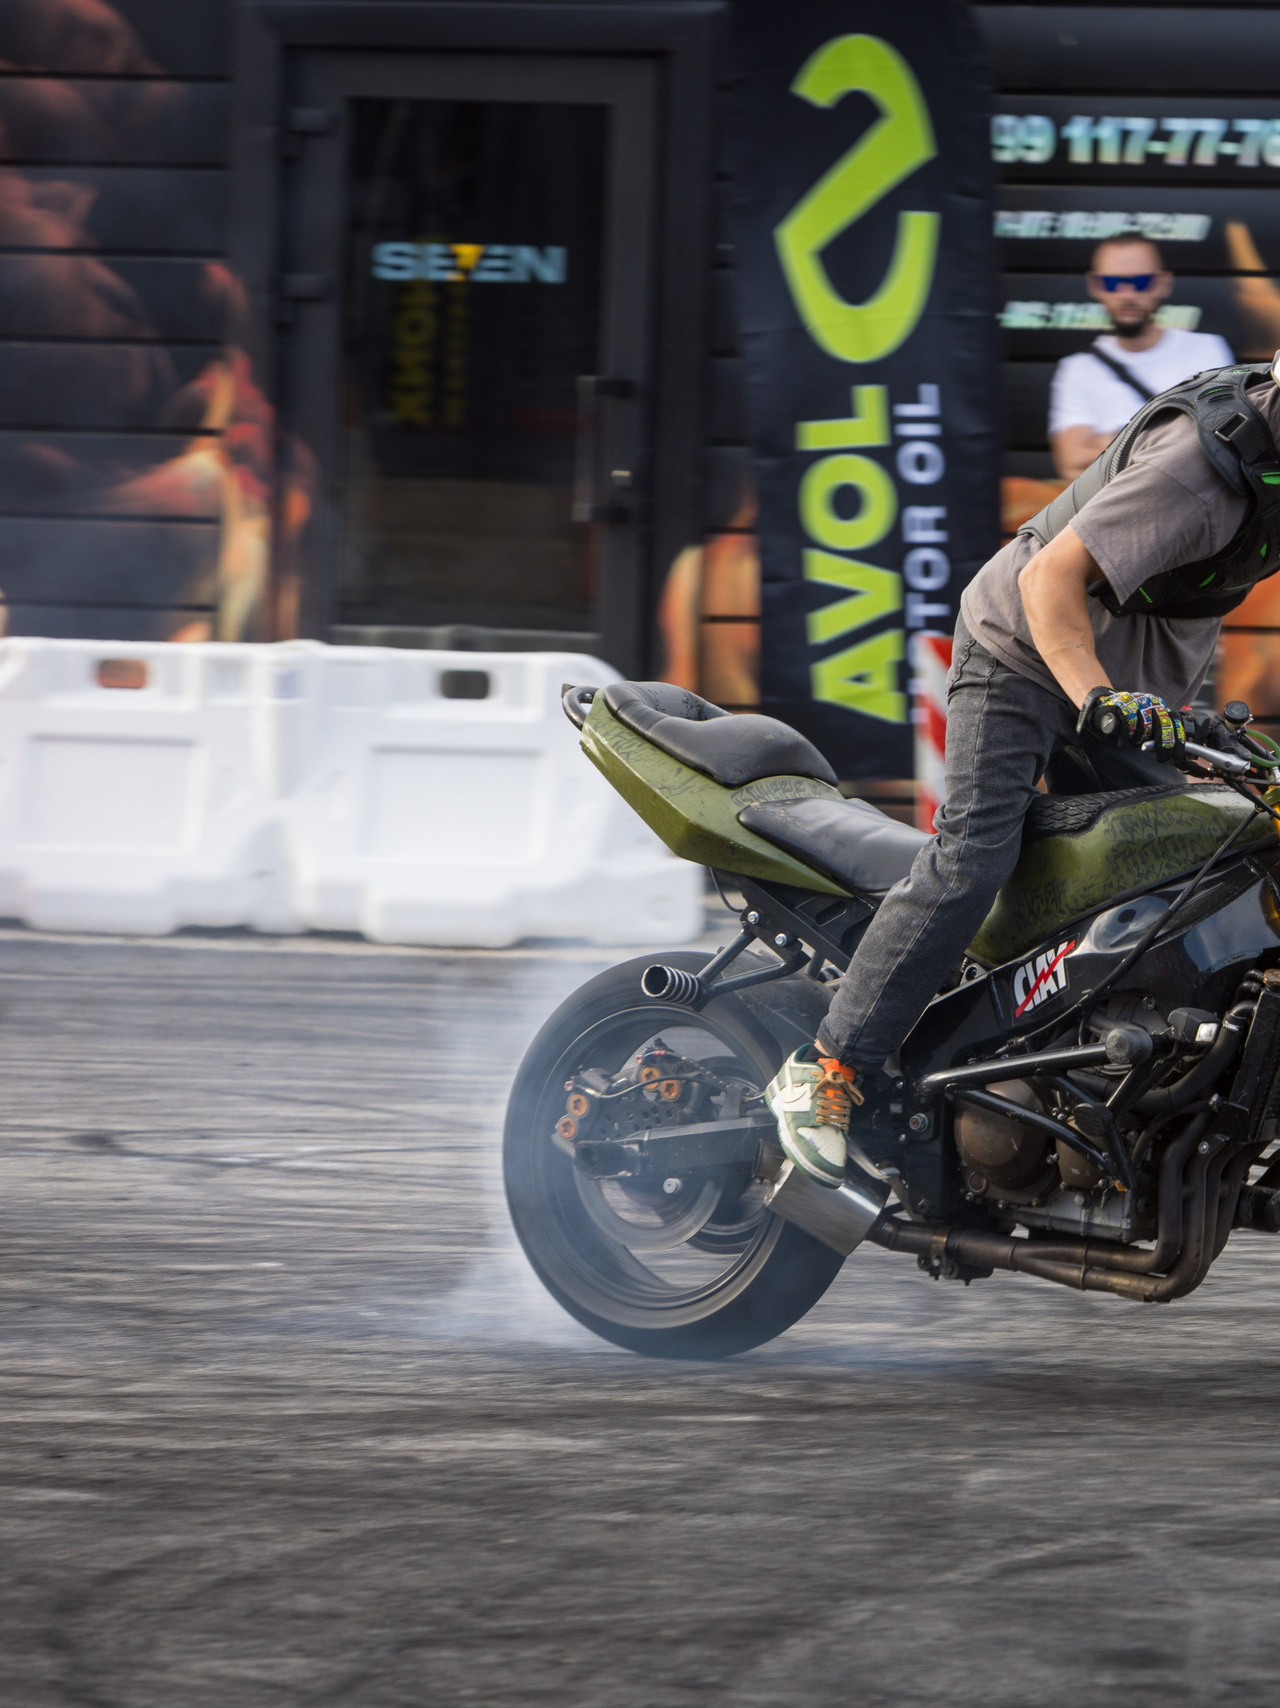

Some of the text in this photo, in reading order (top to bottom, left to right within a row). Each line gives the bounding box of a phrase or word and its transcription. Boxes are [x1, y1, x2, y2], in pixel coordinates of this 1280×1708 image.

[796, 384, 908, 724] AVOL
[893, 383, 952, 724] TOR OIL
